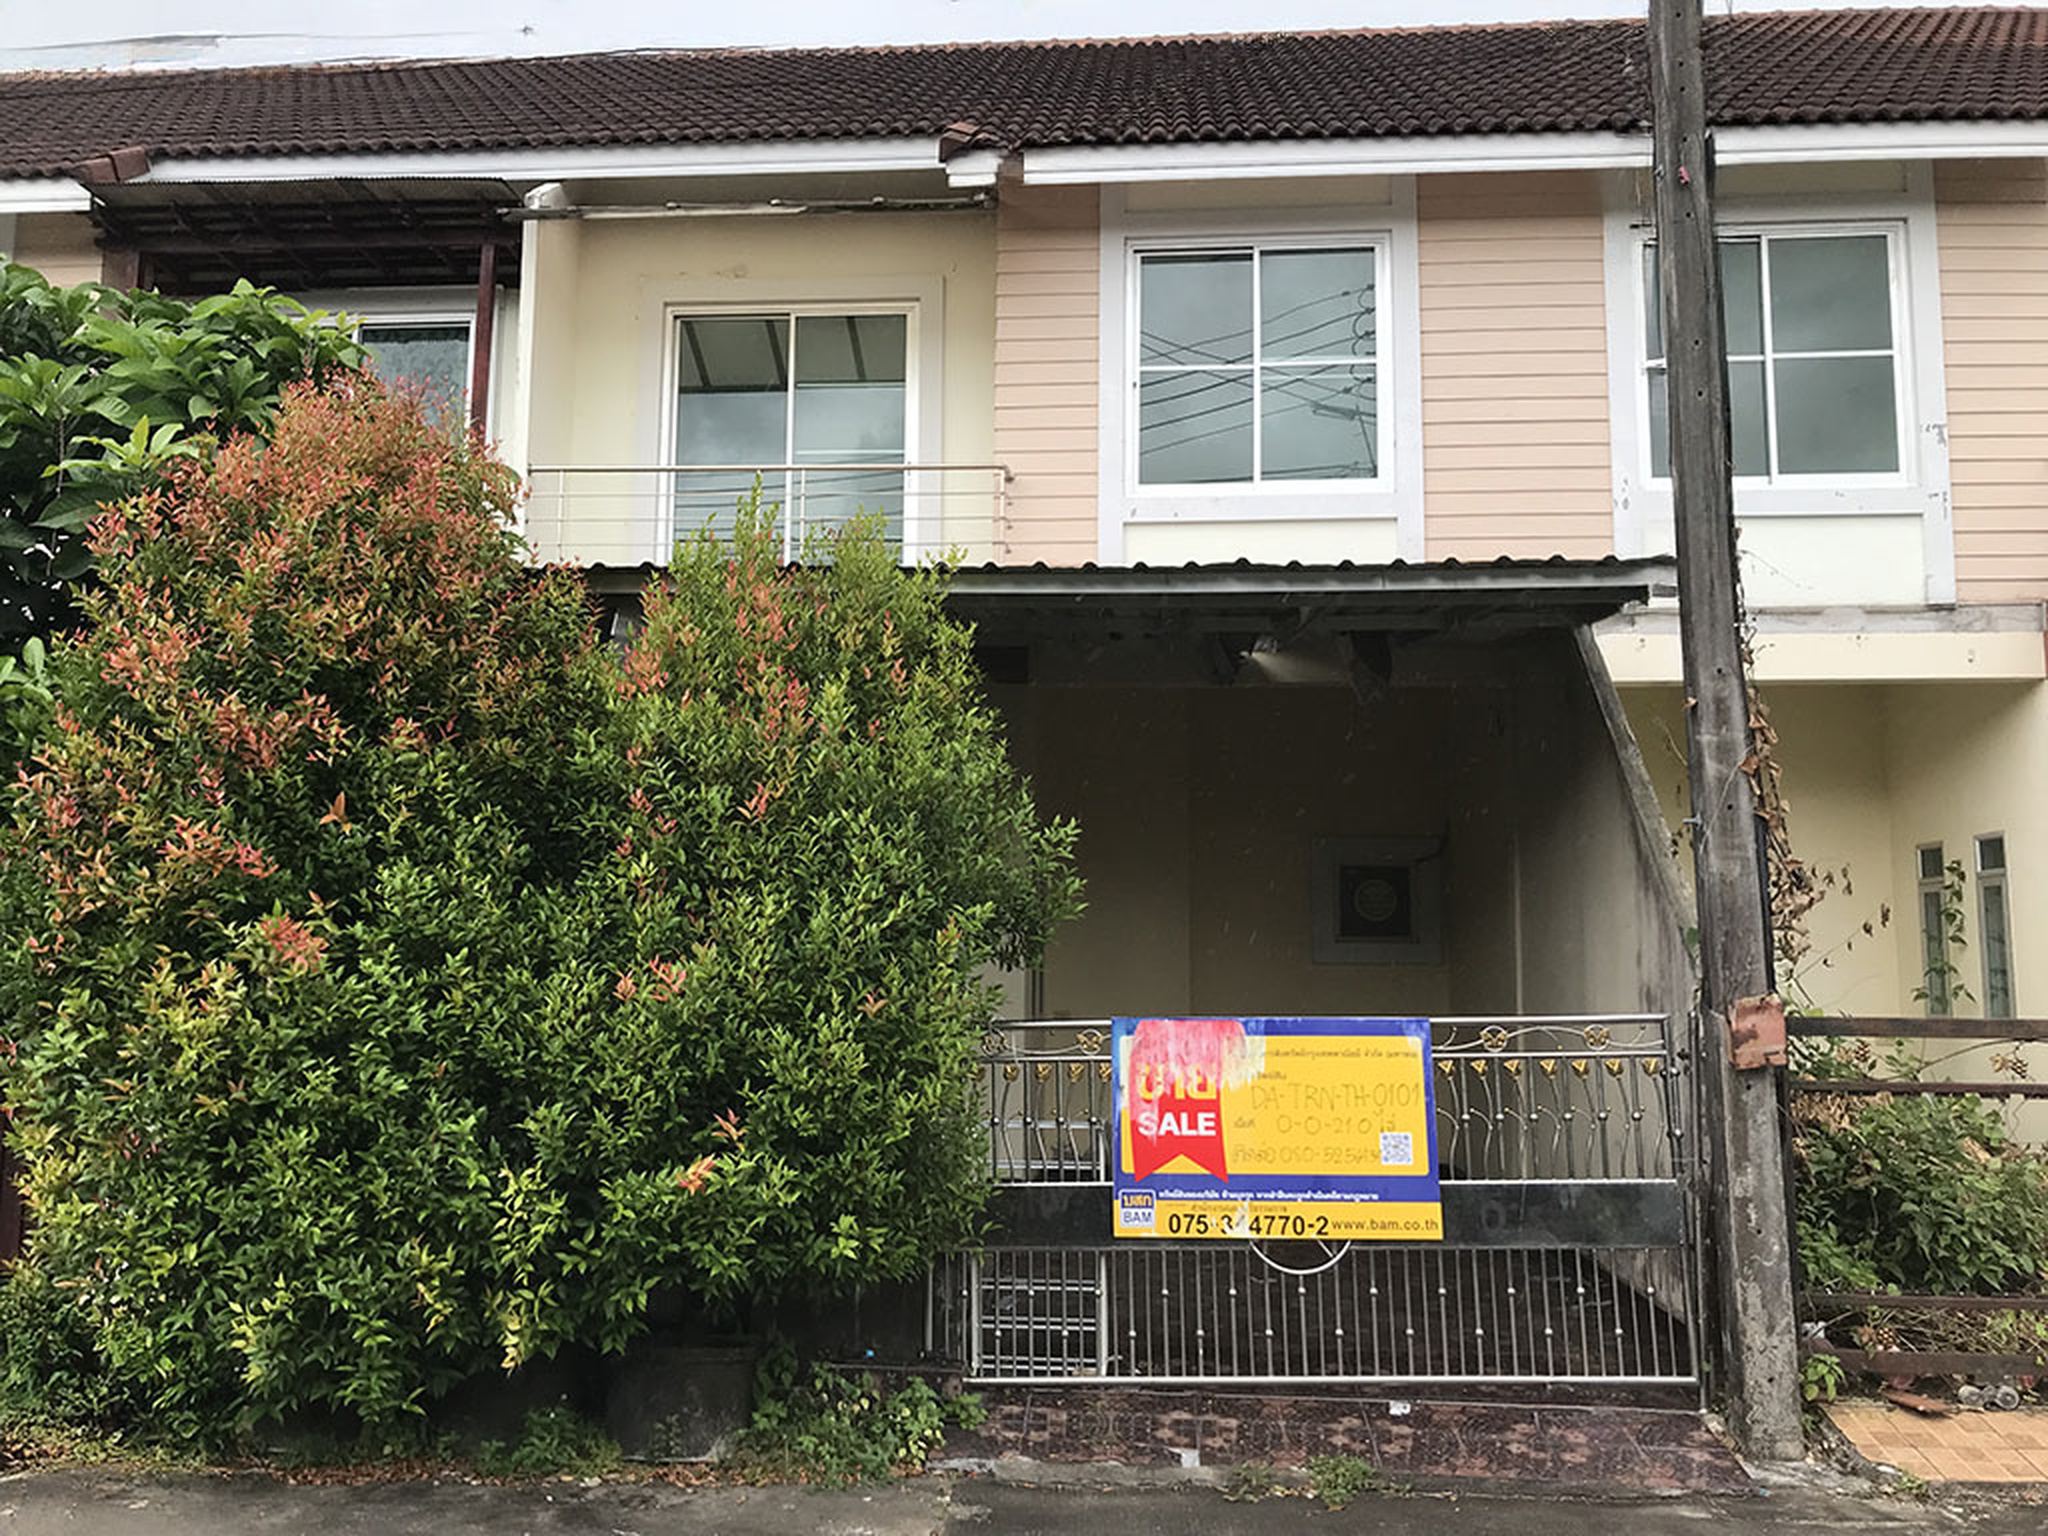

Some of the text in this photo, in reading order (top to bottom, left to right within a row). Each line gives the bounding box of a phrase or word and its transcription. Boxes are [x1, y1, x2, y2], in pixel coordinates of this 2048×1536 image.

[1138, 1112, 1216, 1138] SALE
[1123, 1210, 1152, 1224] BAM
[1332, 1217, 1439, 1232] www.bam.co.th
